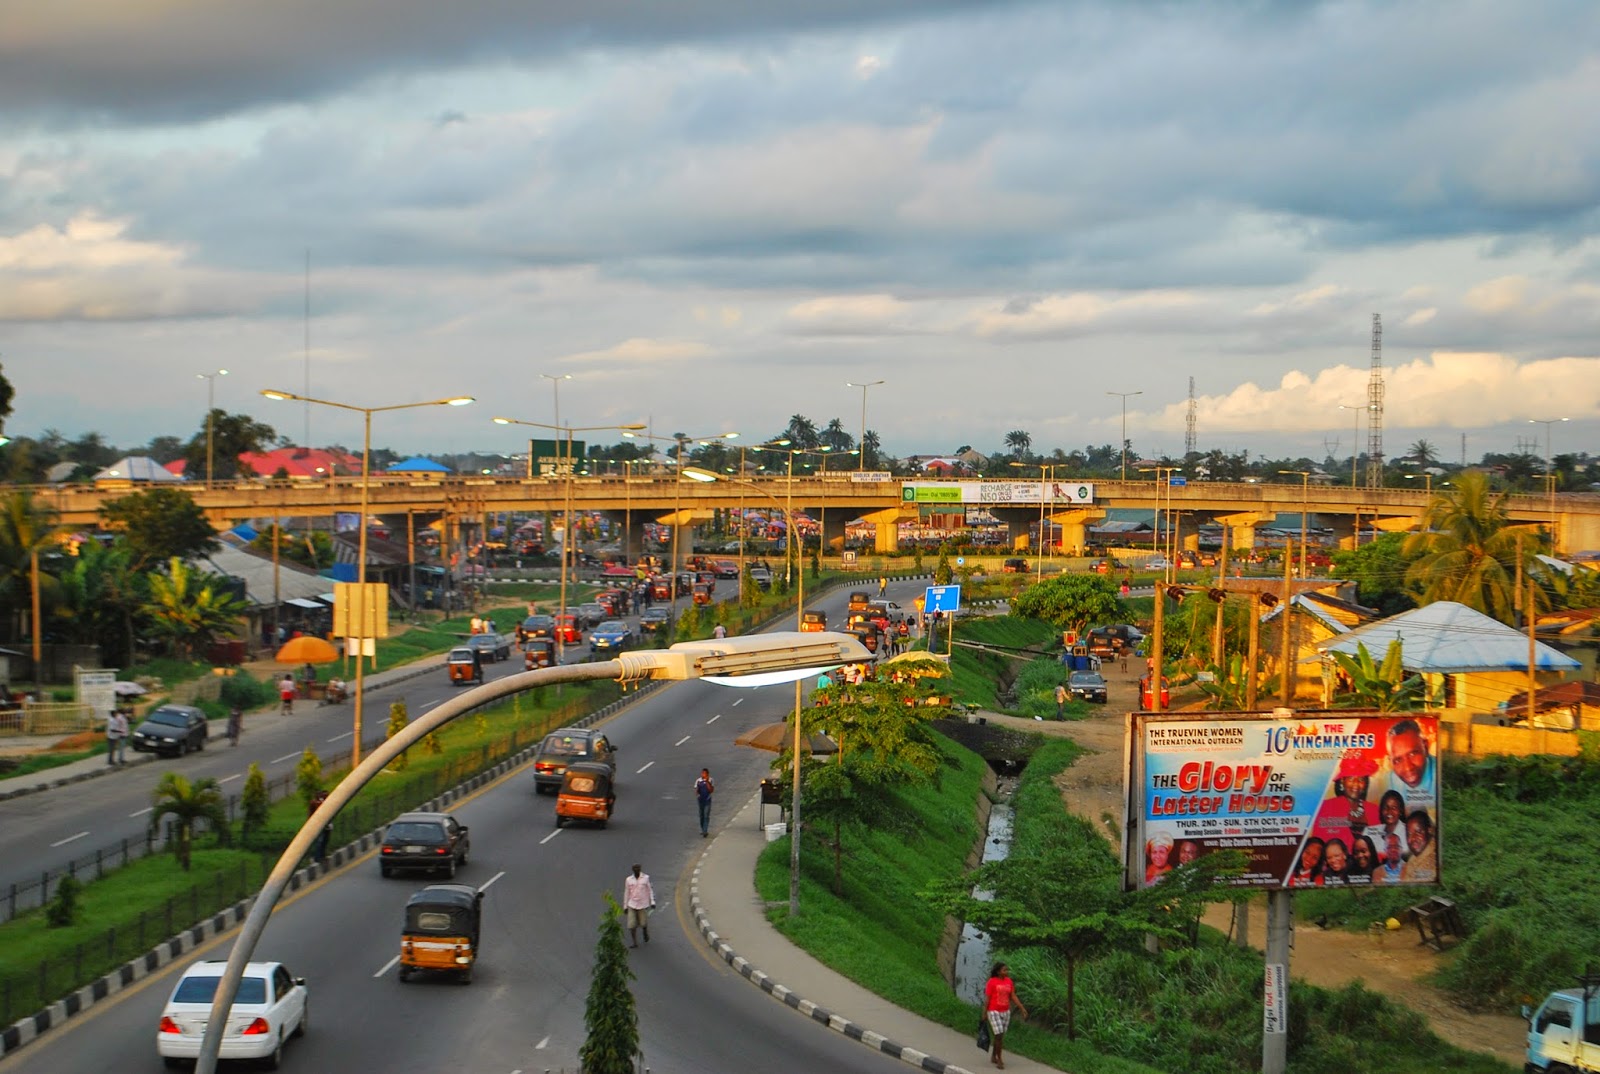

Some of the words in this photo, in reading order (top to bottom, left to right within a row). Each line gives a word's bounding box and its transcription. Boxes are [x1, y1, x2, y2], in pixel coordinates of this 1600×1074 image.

[980, 484, 1012, 492] RECHARGE
[1149, 729, 1165, 738] THE
[1167, 728, 1209, 737] TRUEVINE
[1210, 728, 1244, 736] WOMEN
[1324, 724, 1344, 733] THE
[1150, 738, 1206, 746] INTERNATIONAL
[1293, 734, 1374, 748] KINGMAKERS
[1152, 774, 1178, 788] THE
[1178, 760, 1273, 795] Glory
[1270, 772, 1286, 782] OF
[1268, 783, 1291, 792] THE
[1152, 796, 1222, 816] Latter
[1228, 794, 1294, 814] House
[1176, 820, 1199, 828] THUR.
[1224, 818, 1242, 826] SUN.
[1244, 818, 1259, 826] 5TH
[1260, 818, 1278, 826] OCT,
